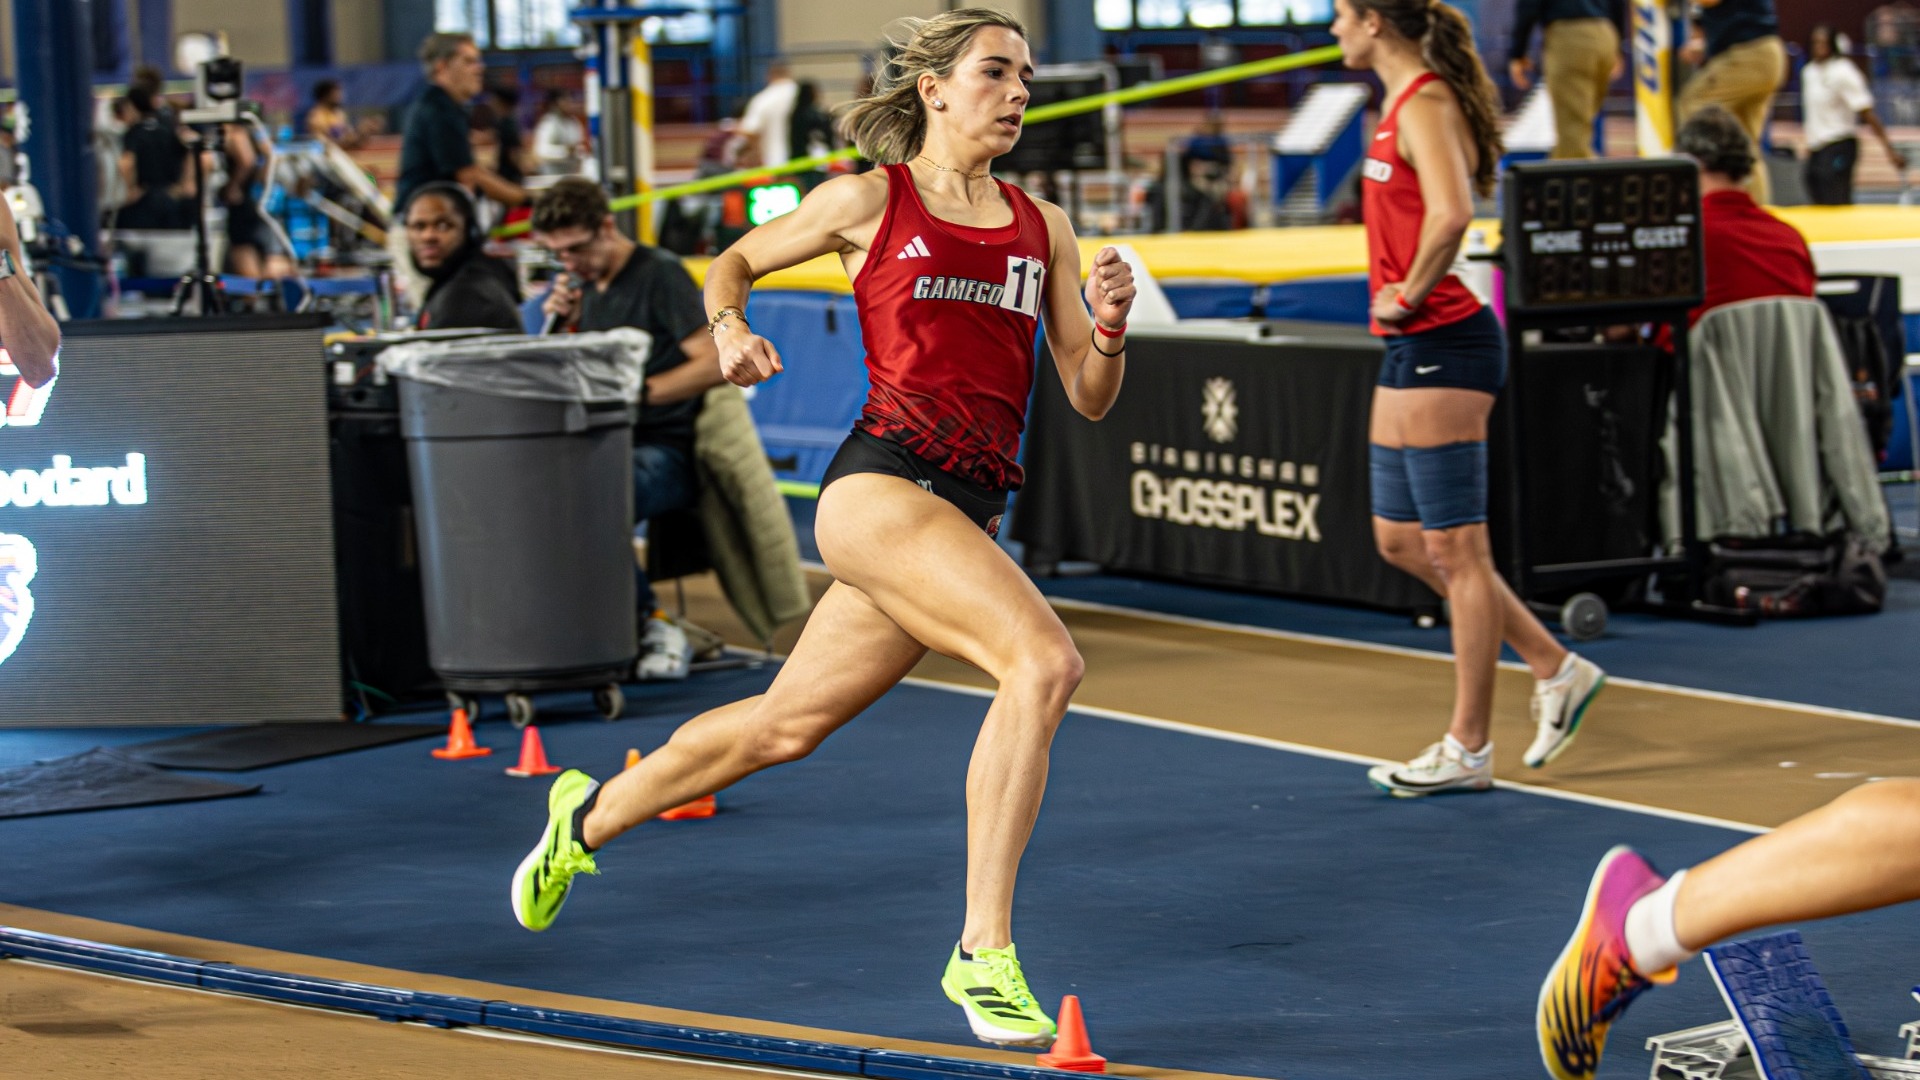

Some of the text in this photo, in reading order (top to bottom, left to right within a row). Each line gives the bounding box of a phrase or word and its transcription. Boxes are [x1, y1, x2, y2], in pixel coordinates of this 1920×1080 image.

[1531, 229, 1582, 254] HOME
[1633, 225, 1689, 249] GUEST
[1131, 441, 1319, 487] BIRMINGHAM
